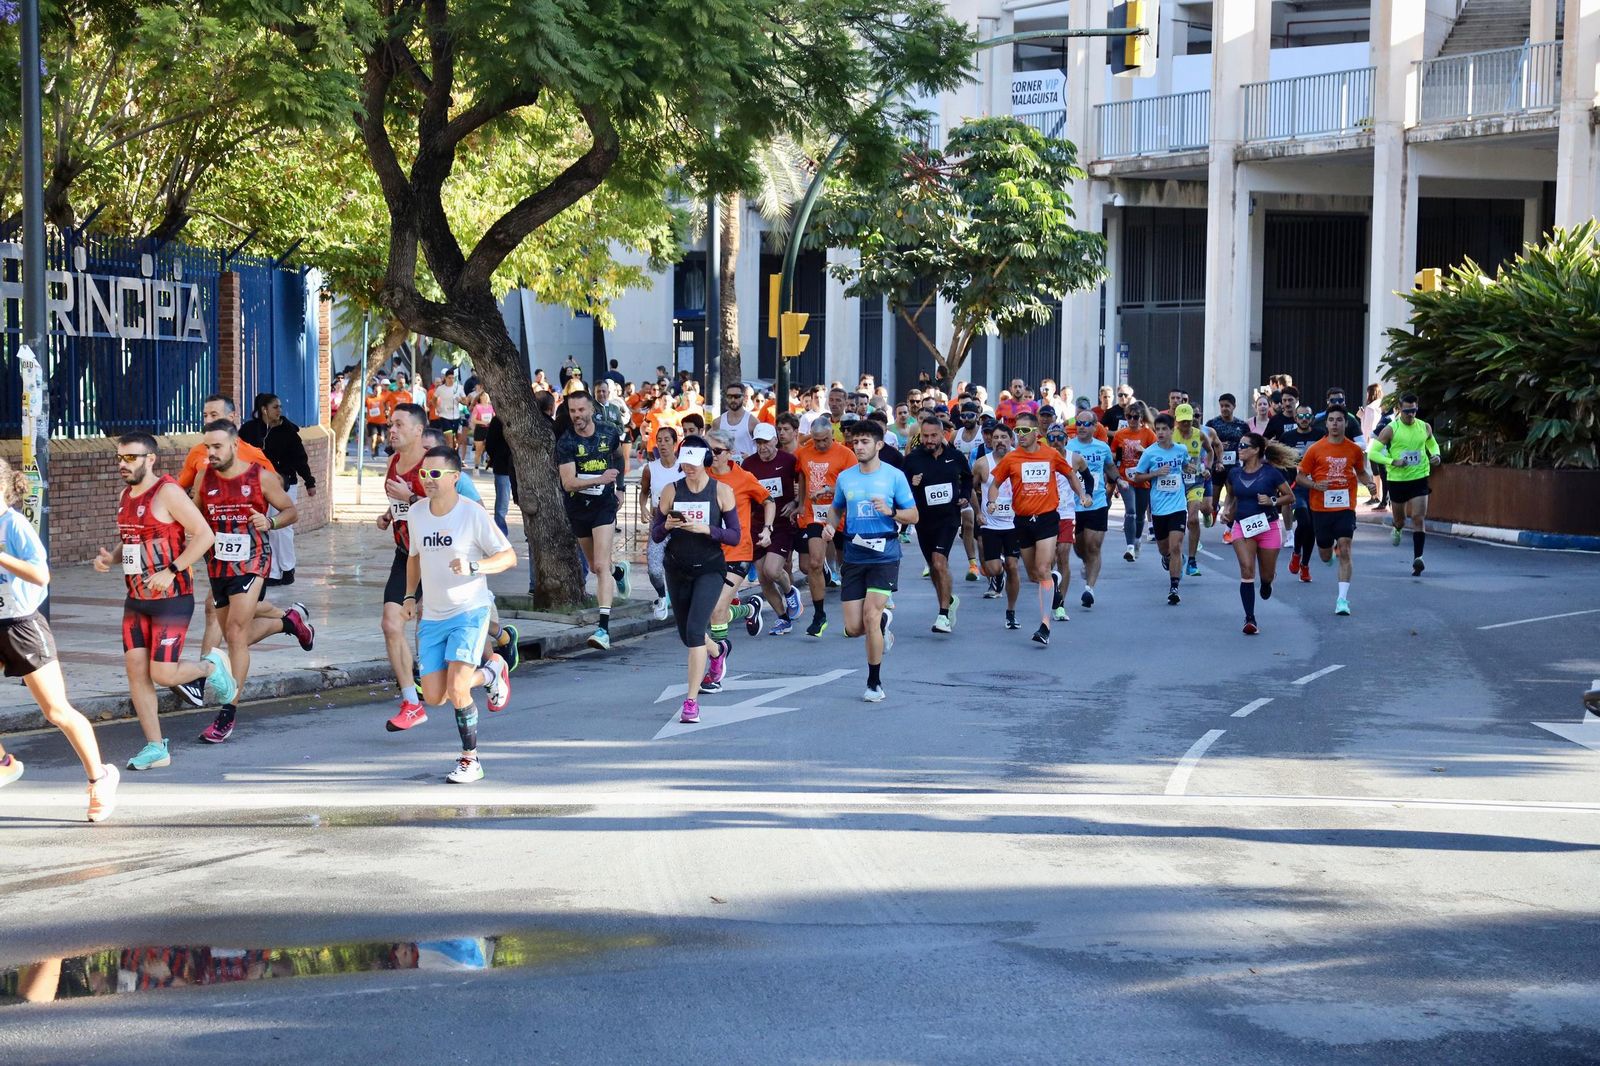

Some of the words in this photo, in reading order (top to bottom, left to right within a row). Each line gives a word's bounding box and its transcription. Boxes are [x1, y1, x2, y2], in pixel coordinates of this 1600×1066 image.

[1012, 80, 1042, 93] CORNER
[1045, 79, 1059, 90] VIP
[1012, 91, 1058, 105] MALAGUISTA
[1082, 452, 1101, 463] erja
[930, 490, 949, 499] 606
[681, 510, 704, 519] 58
[816, 511, 828, 519] 34
[1245, 520, 1264, 532] 242
[423, 532, 453, 547] nike
[218, 542, 242, 553] 787
